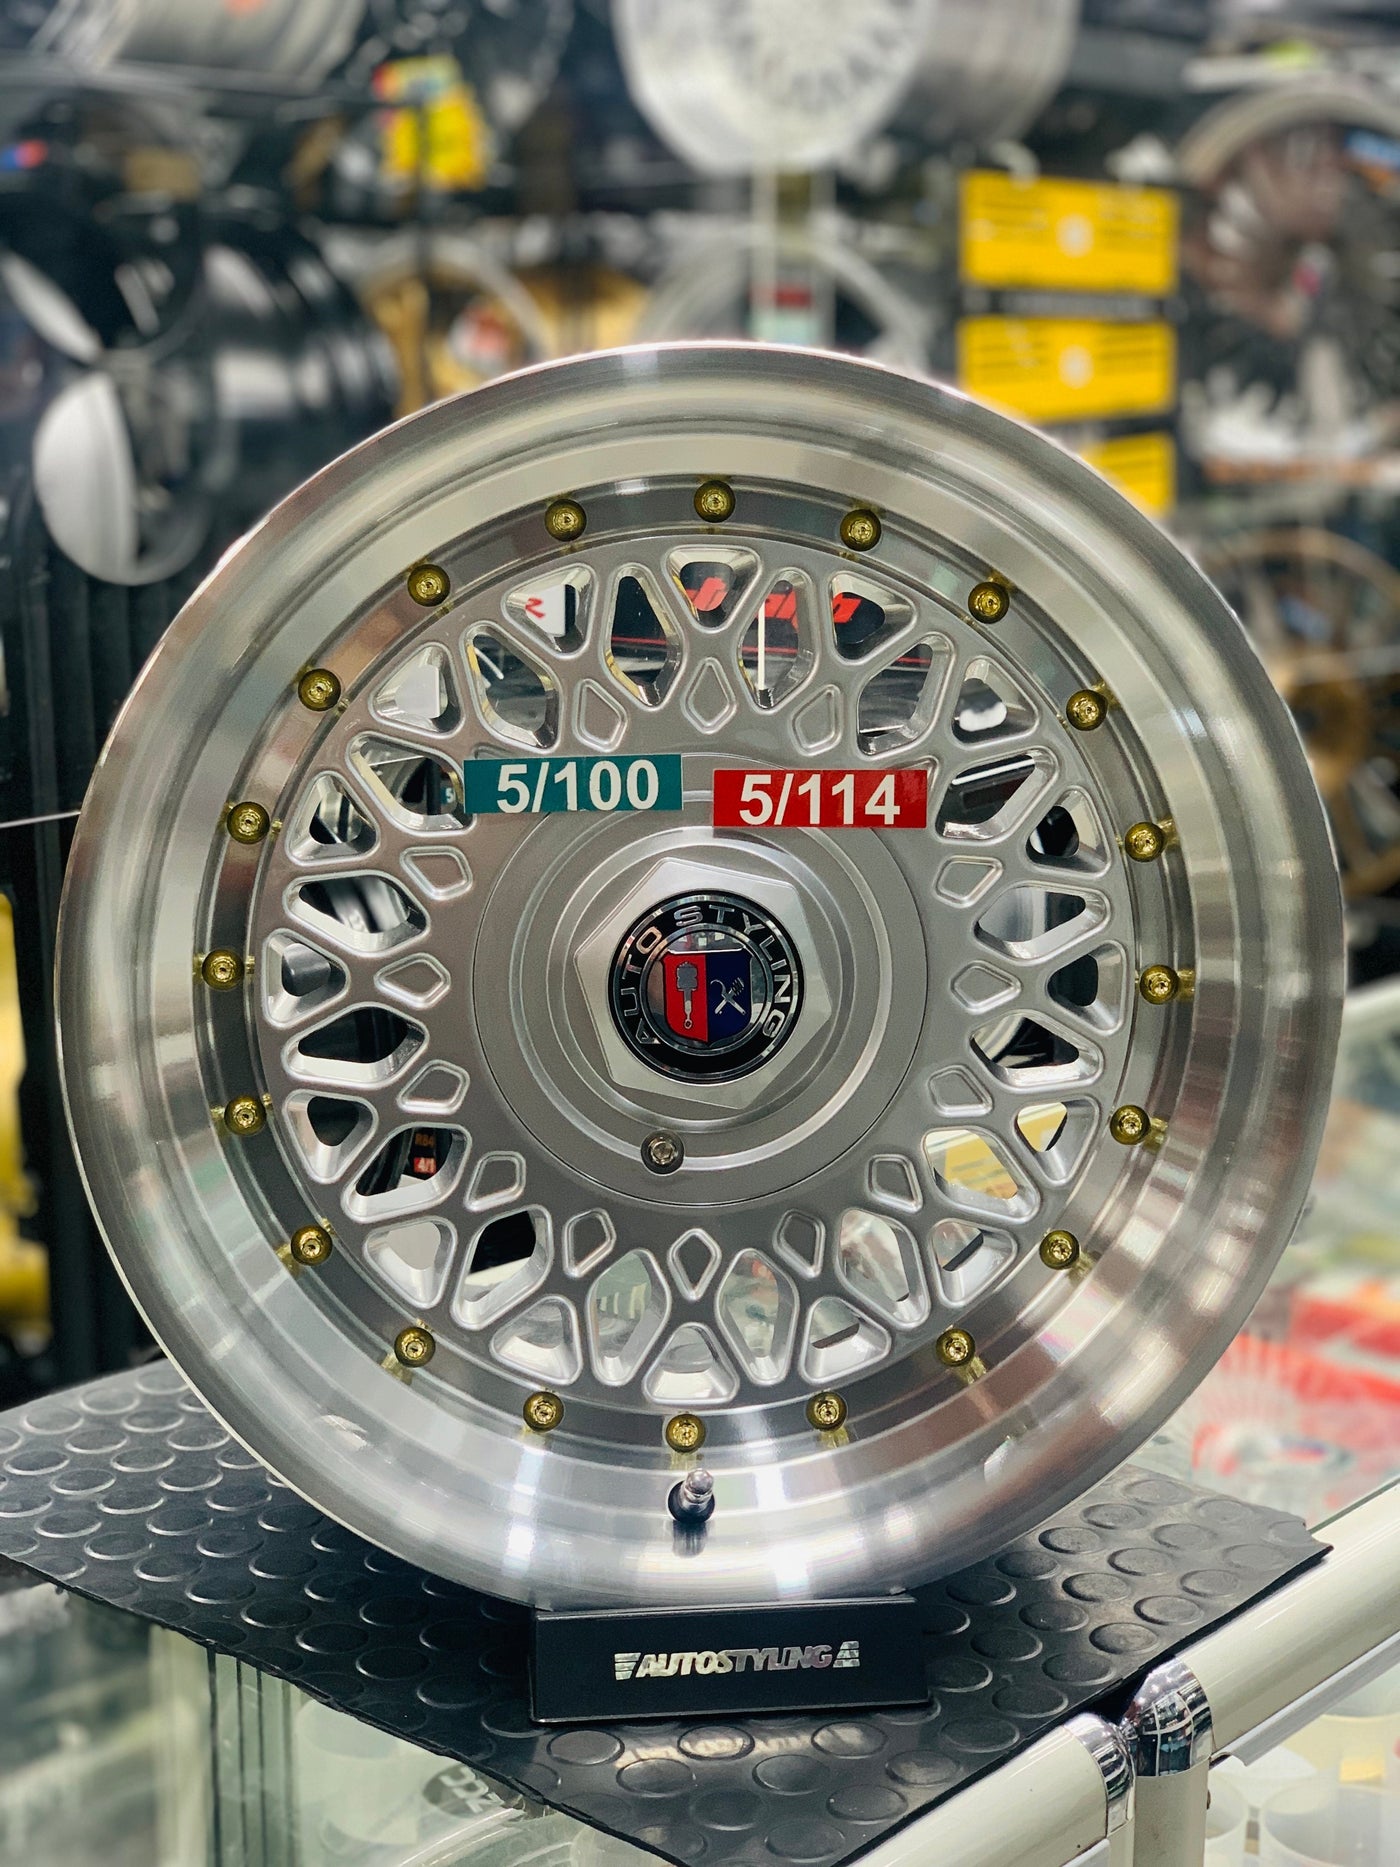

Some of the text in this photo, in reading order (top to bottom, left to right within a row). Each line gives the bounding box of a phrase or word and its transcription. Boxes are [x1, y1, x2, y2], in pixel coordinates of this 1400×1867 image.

[497, 759, 659, 813] 5/100
[739, 773, 901, 826] 5/114
[620, 905, 793, 1045] AUTO STYLING
[635, 1644, 833, 1678] AUTOSTYLING
